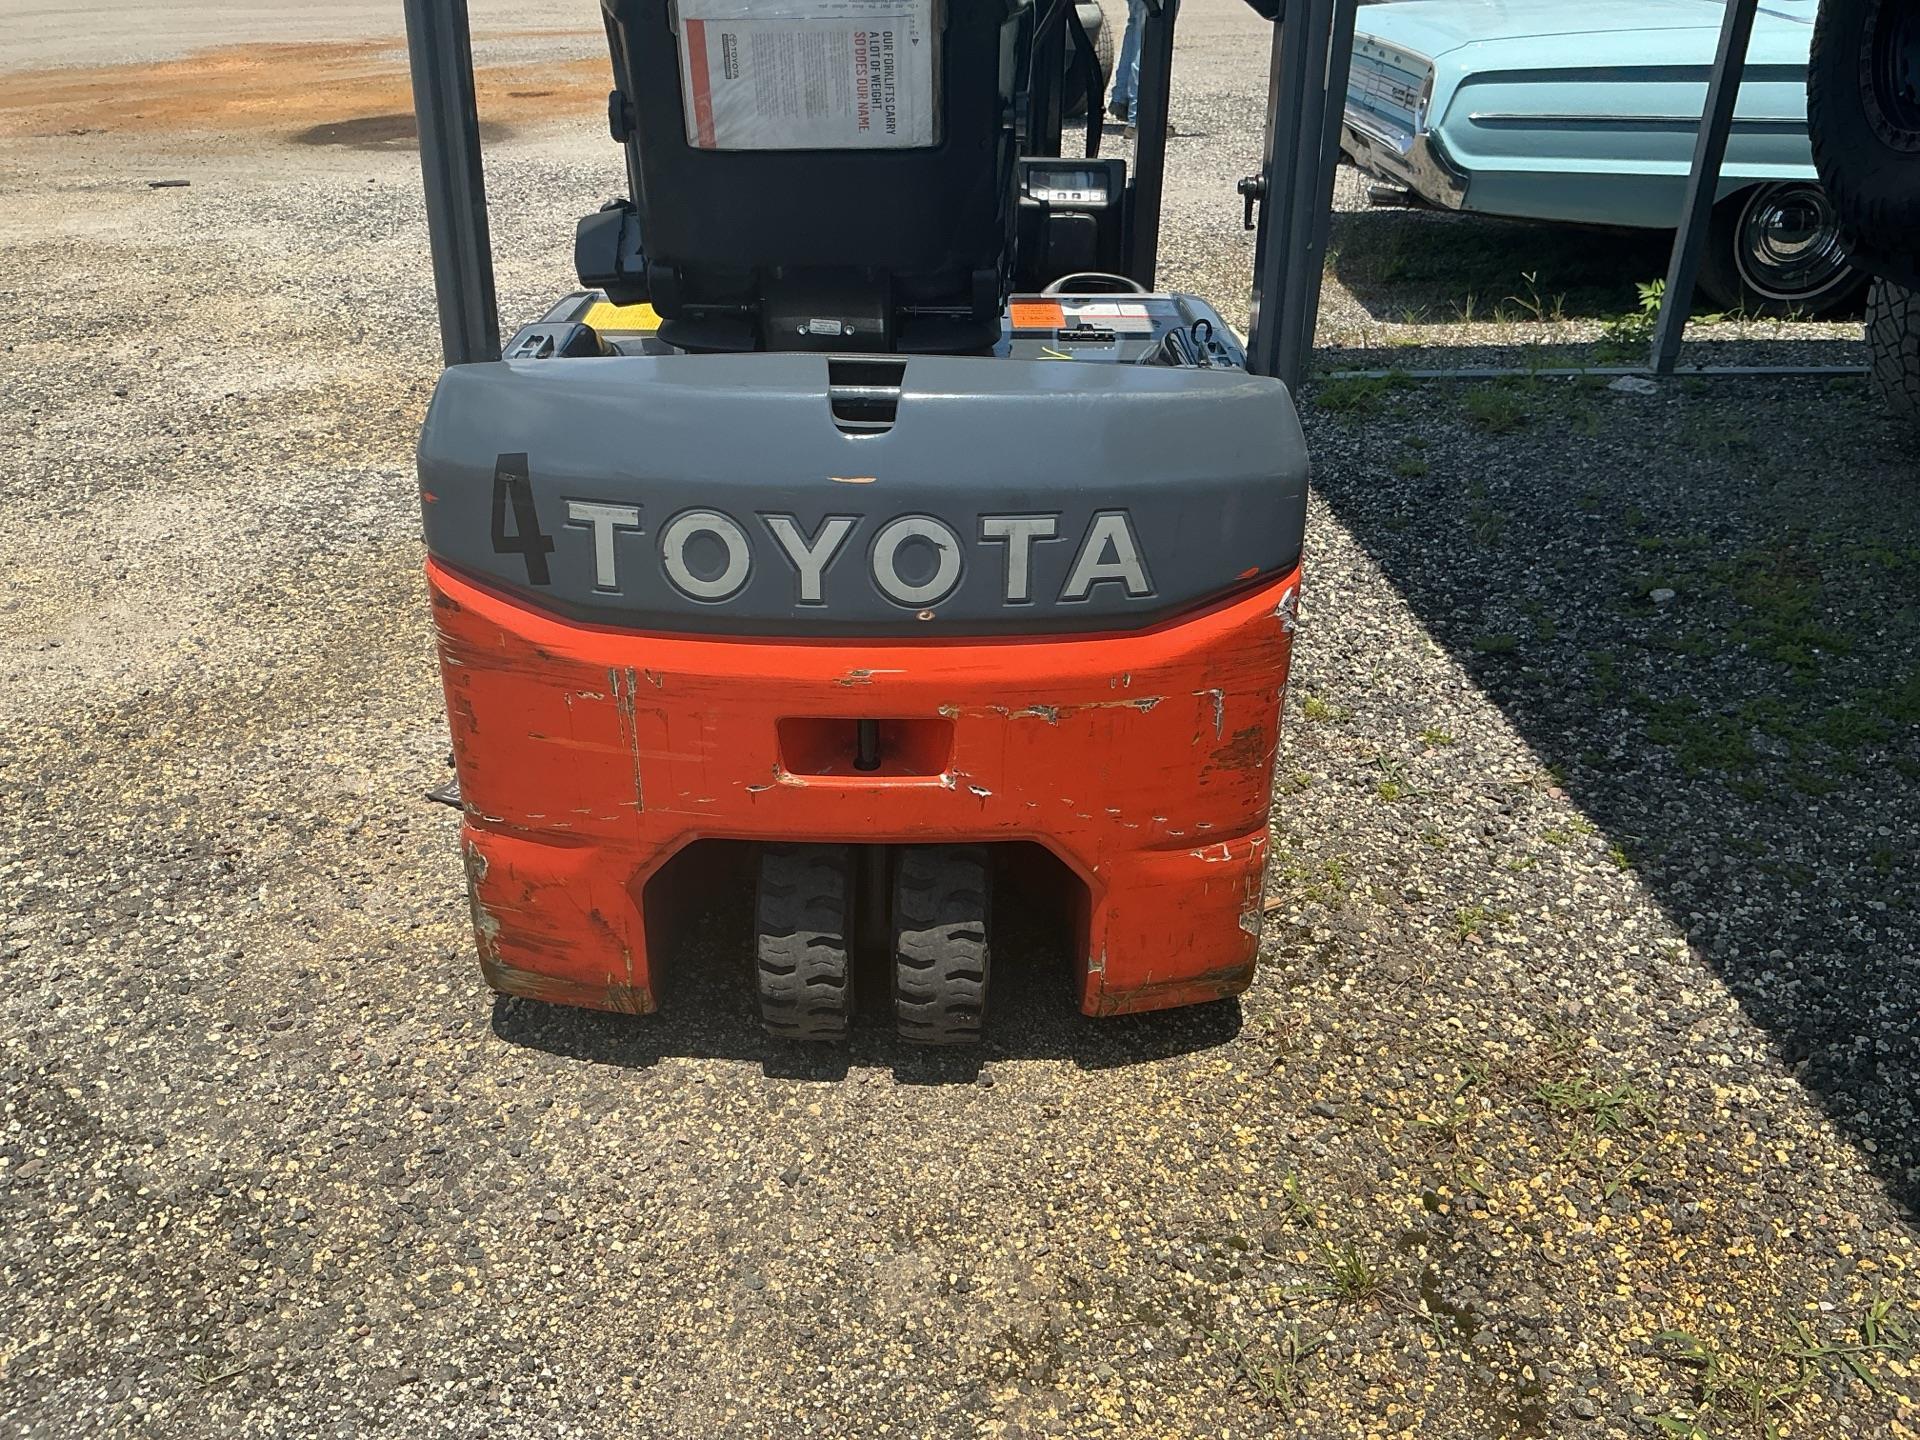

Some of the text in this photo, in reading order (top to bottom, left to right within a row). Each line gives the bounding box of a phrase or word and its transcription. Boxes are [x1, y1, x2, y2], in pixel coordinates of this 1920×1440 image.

[731, 47, 739, 79] TOYOTA
[854, 31, 870, 133] SO DOES OUR NAME.
[870, 40, 880, 58] LOT
[870, 60, 880, 72] OF
[883, 31, 896, 135] OUR FORKLIFTS CARRY
[871, 74, 882, 112] WEIGHT.
[491, 452, 555, 586] 4
[566, 500, 1150, 604] TOYOTA
